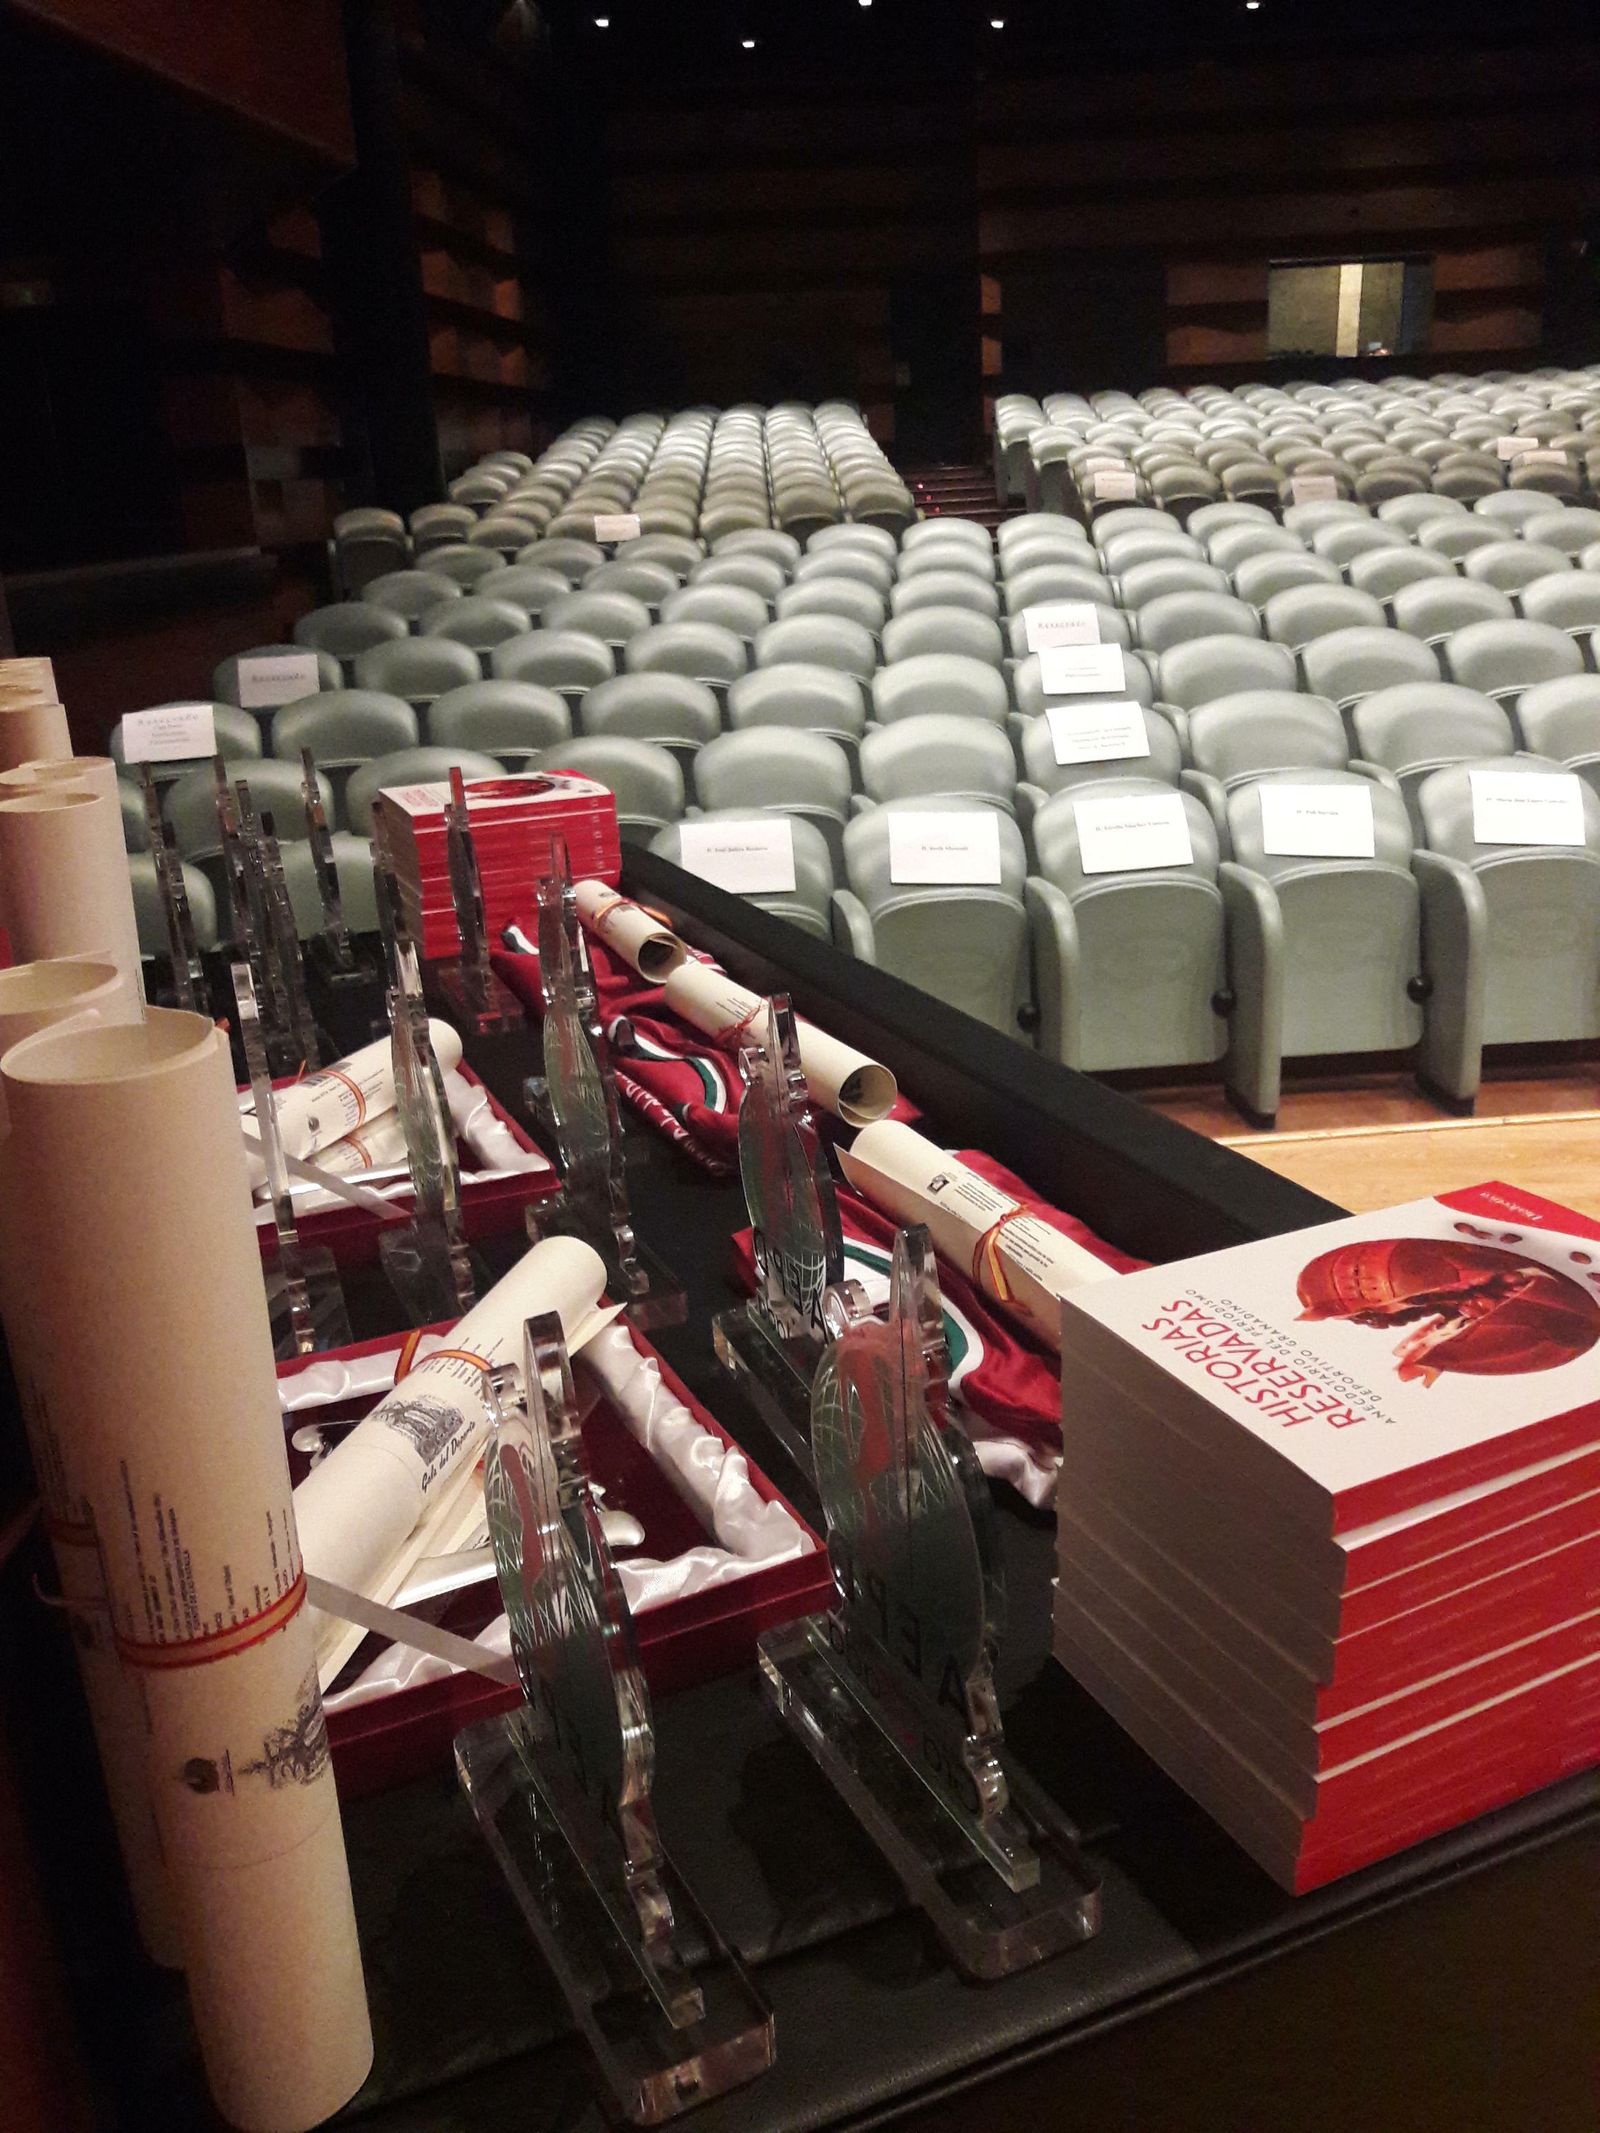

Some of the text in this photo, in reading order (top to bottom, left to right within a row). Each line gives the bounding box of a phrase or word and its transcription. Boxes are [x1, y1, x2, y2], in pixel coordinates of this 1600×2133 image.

[1141, 1318, 1313, 1427] HISTORIAS
[1161, 1299, 1366, 1429] RESERVADAS
[1185, 1289, 1396, 1424] ANECDOTARIO DEL PERIODISMO
[1221, 1299, 1382, 1401] DEPORTIVO GRANADINO
[439, 1445, 449, 1470] del
